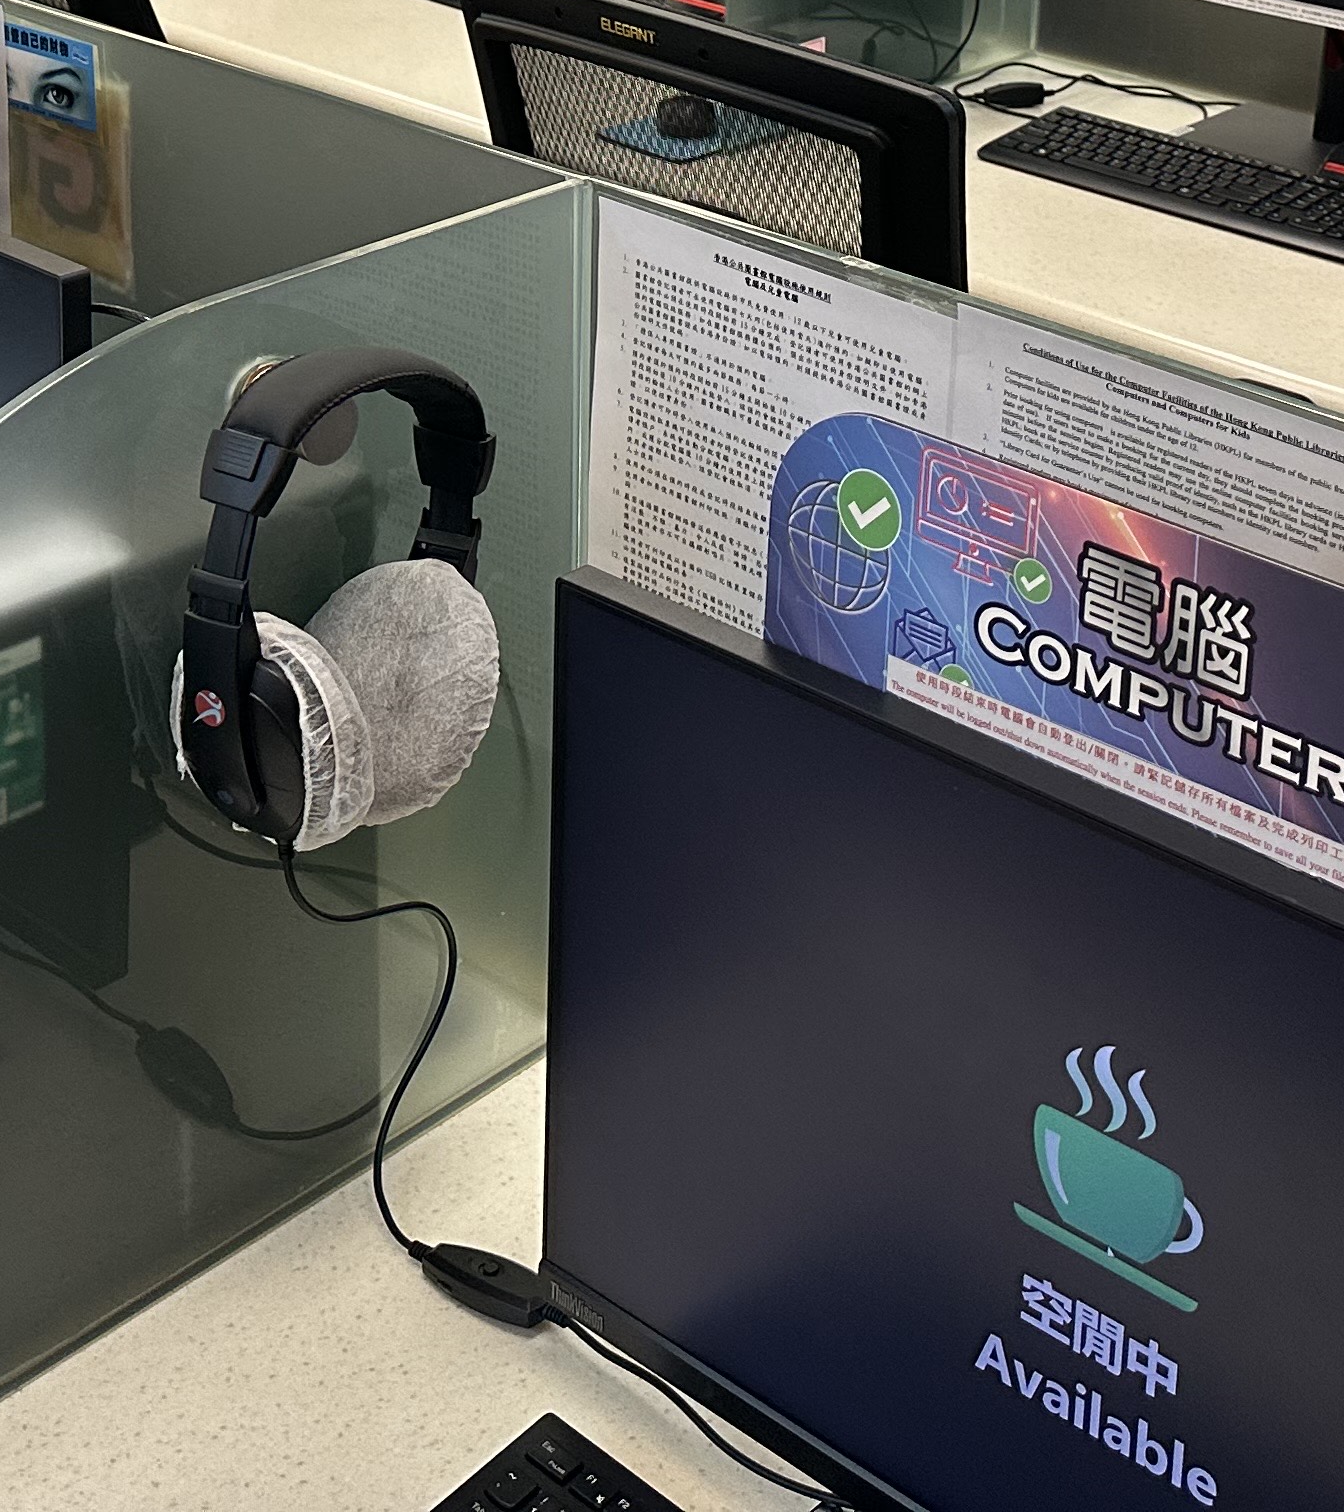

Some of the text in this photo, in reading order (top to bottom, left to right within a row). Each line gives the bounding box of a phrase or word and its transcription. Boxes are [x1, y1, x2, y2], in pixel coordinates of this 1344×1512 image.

[599, 15, 658, 45] ELEGANT
[1022, 342, 1064, 365] Conditions
[1064, 358, 1074, 369] of
[1074, 360, 1090, 375] Use
[1091, 366, 1104, 379] for
[1104, 371, 1118, 384] the
[1118, 376, 1160, 399] Computer
[1161, 390, 1198, 412] Facilities
[1199, 405, 1209, 416] of
[1210, 408, 1224, 421] the
[1225, 412, 1249, 430] Hong
[1251, 421, 1274, 439] Kong
[1275, 430, 1304, 449] Public
[1105, 382, 1251, 440] Computers and Computers for Kids
[1081, 544, 1254, 697] 電腦
[891, 679, 905, 693] The
[906, 688, 939, 708] computer
[940, 703, 955, 715] will
[956, 708, 966, 720] be
[967, 712, 992, 731] logged
[992, 725, 1023, 744] out/shut
[1023, 737, 1045, 754] down
[1047, 749, 1098, 777] automatically
[1100, 771, 1122, 786] when
[1123, 779, 1136, 792] the
[1137, 787, 1166, 806] session
[1167, 800, 1189, 816] ends.
[1191, 808, 1218, 828] Please
[1219, 823, 1262, 847] remember
[1263, 840, 1273, 852] to
[1274, 846, 1294, 861] save
[1295, 855, 1307, 867] all
[1308, 861, 1330, 876] your
[1019, 1273, 1179, 1398] 空閒中
[974, 1333, 1219, 1507] Available
